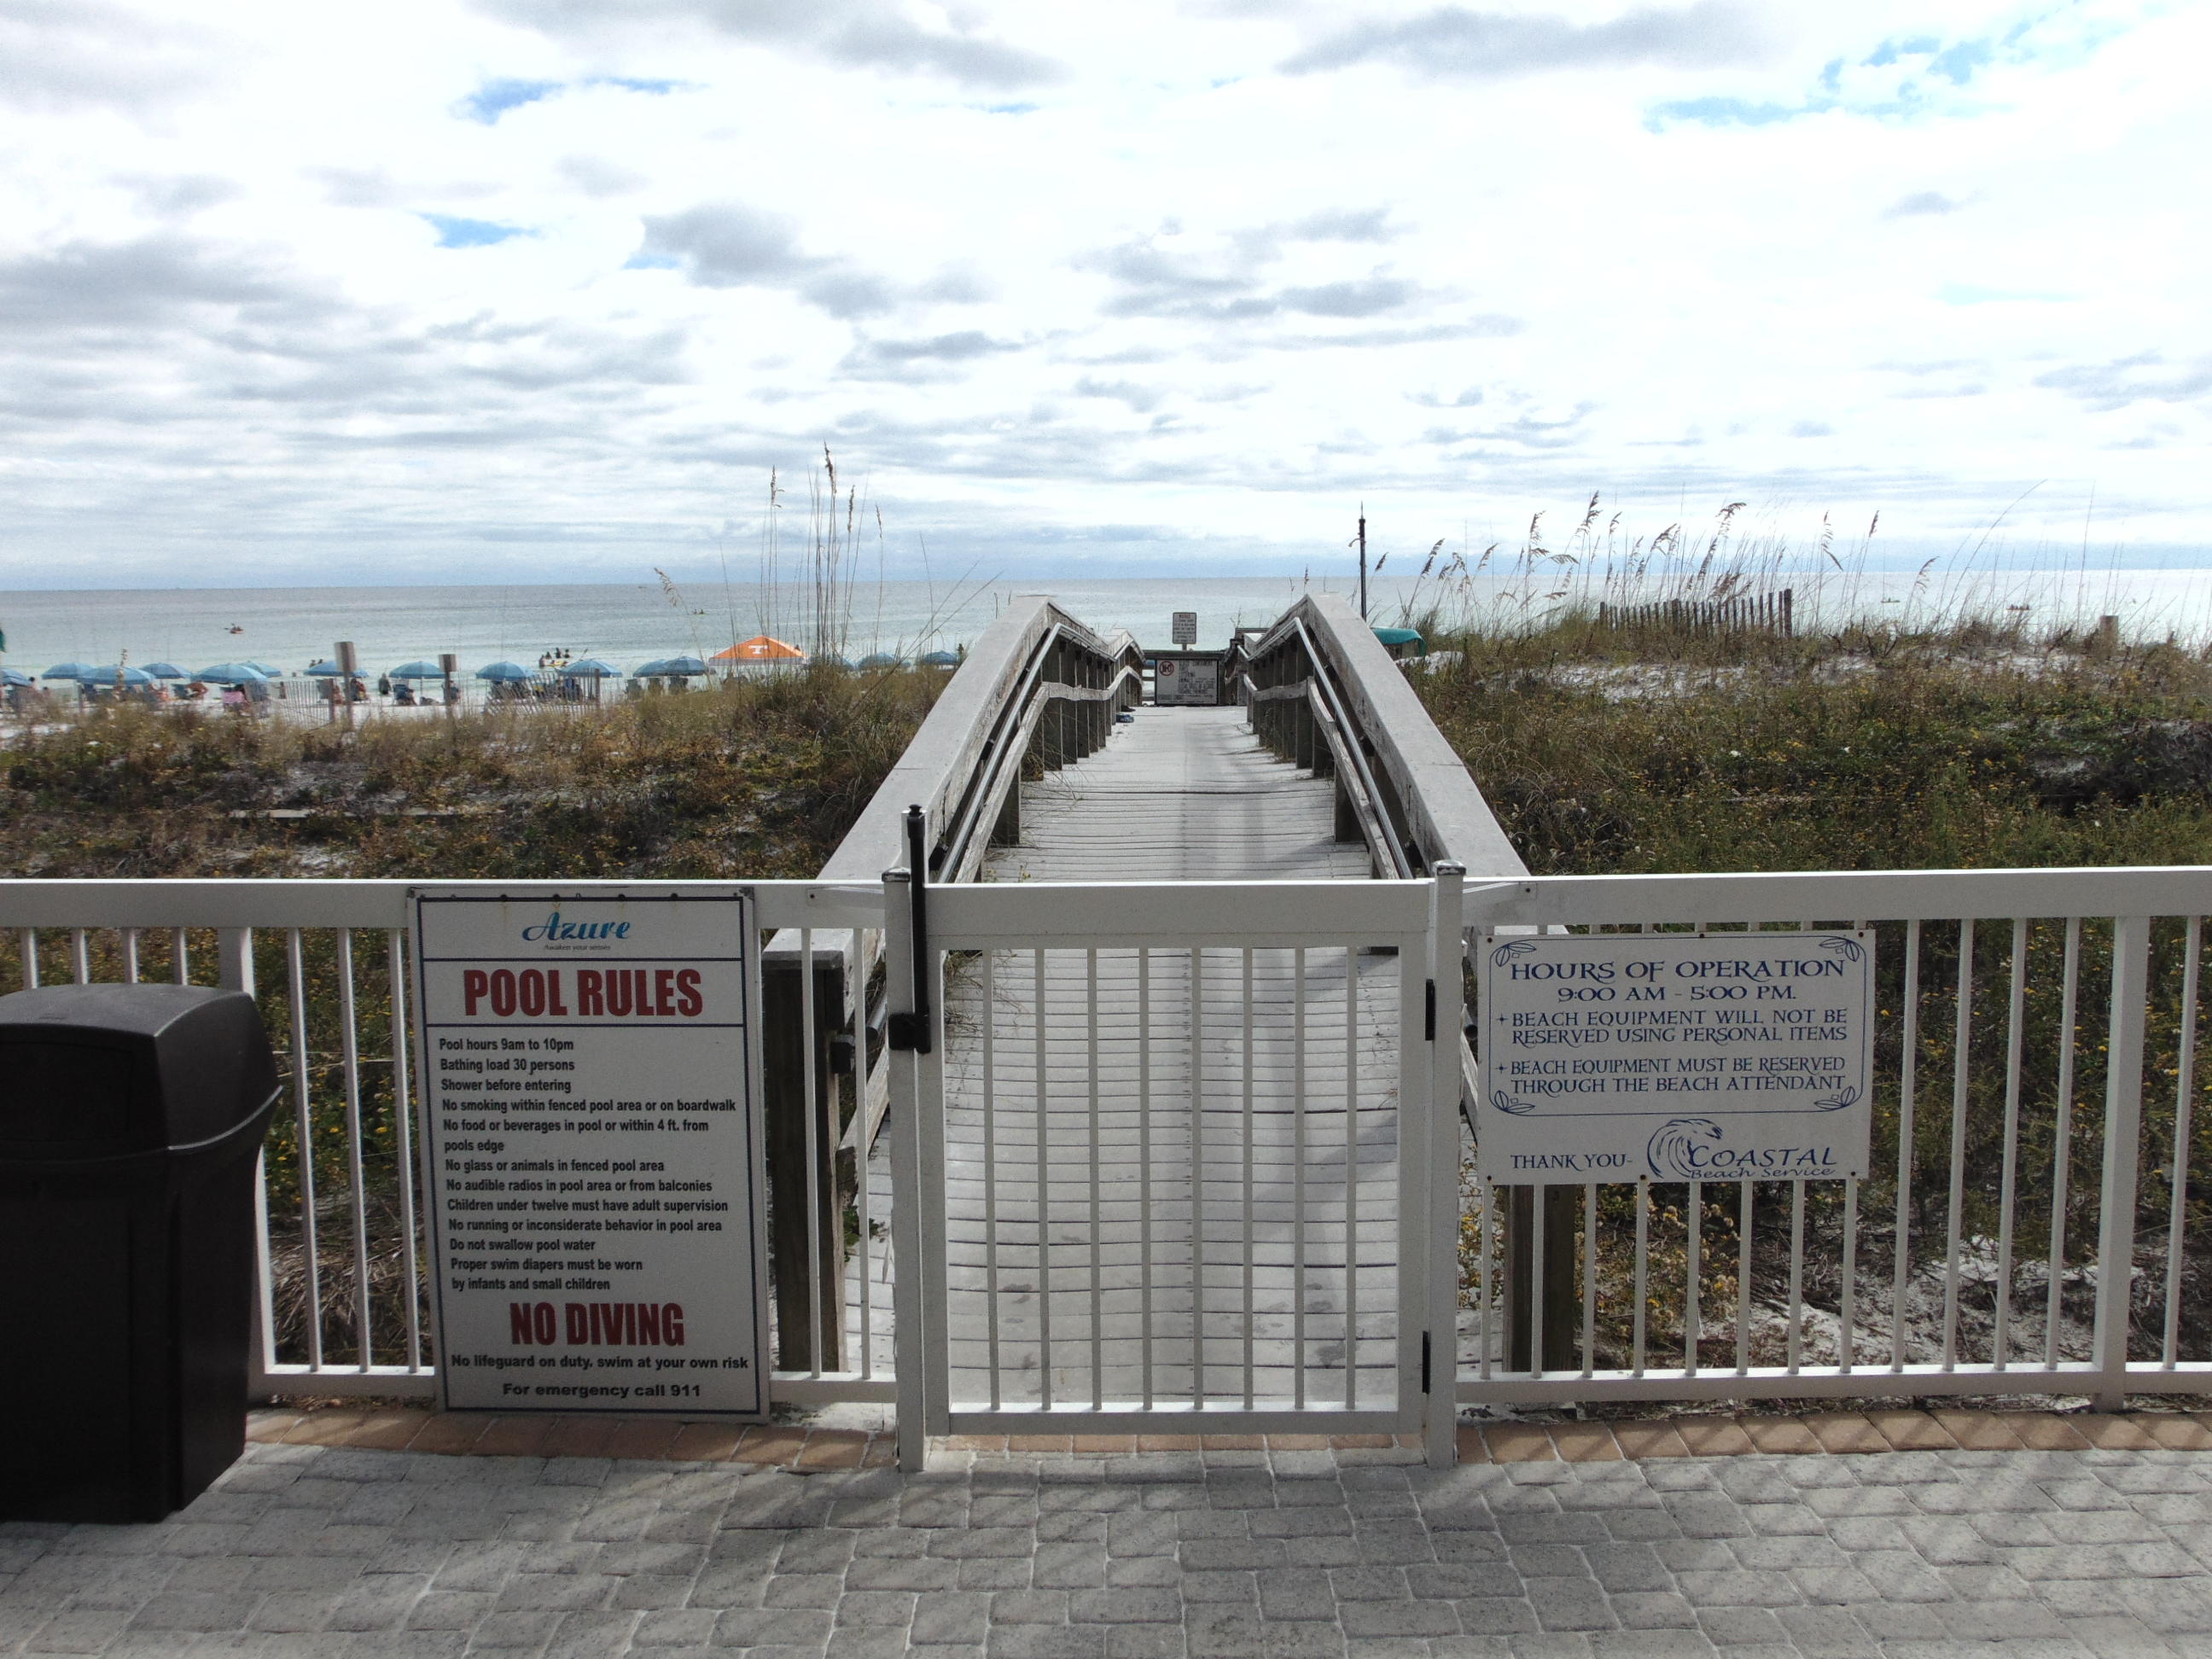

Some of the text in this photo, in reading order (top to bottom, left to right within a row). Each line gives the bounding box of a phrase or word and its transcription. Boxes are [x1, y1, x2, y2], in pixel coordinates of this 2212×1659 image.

[522, 911, 631, 940] Azure
[1511, 959, 1845, 983] HOURS OF OPERATION
[463, 969, 703, 1017] POOL RULES
[1557, 987, 1615, 1003] 9:00
[1626, 987, 1666, 1001] AM
[1690, 986, 1747, 1002] 5:00
[1511, 1009, 1848, 1027] BEACH EQUIPMENT WILL NOT BE
[1511, 1027, 1848, 1048] RESERVED USING PERSONAL ITEMS
[439, 1039, 573, 1053] Pool hours 9am to 10pm
[440, 1058, 575, 1074] Bathing load 30 persons
[1511, 1057, 1845, 1075] BEACH EQUIPMENT MUST BE RESERVED
[441, 1079, 571, 1093] Shower before entering
[1511, 1075, 1845, 1097] THROUGH THE BEACH ATTENDANT
[442, 1099, 736, 1114] No smoking within fenced pool area or on boardwalk
[444, 1120, 709, 1133] No food or beverages in pool or within 4 ft. from
[445, 1139, 504, 1154] pools edge
[1510, 1154, 1584, 1171] THANK
[1689, 1145, 1837, 1167] COASTAL
[445, 1159, 664, 1173] No glass or animals in fenced pool area
[1691, 1167, 1837, 1179] Beach Service
[446, 1179, 713, 1193] No audible radios in pool area or from balconies
[447, 1199, 728, 1214] Children under twelve must have adult supervision
[449, 1219, 722, 1233] No running or inconsiderate behavior in pool area
[451, 1238, 596, 1253] Do not swallow pool water
[451, 1258, 643, 1272] Proper swim diapers must be worn
[451, 1278, 610, 1291] by infants and small children
[509, 1302, 684, 1346] NO DIVING
[451, 1354, 469, 1365] No
[474, 1354, 535, 1370] lifeguard
[539, 1357, 556, 1366] on
[597, 1356, 632, 1367] swim
[637, 1357, 651, 1368] at
[655, 1359, 685, 1371] your
[690, 1359, 718, 1368] own
[723, 1357, 748, 1369] risk
[503, 1383, 701, 1398] For emergency call 911
